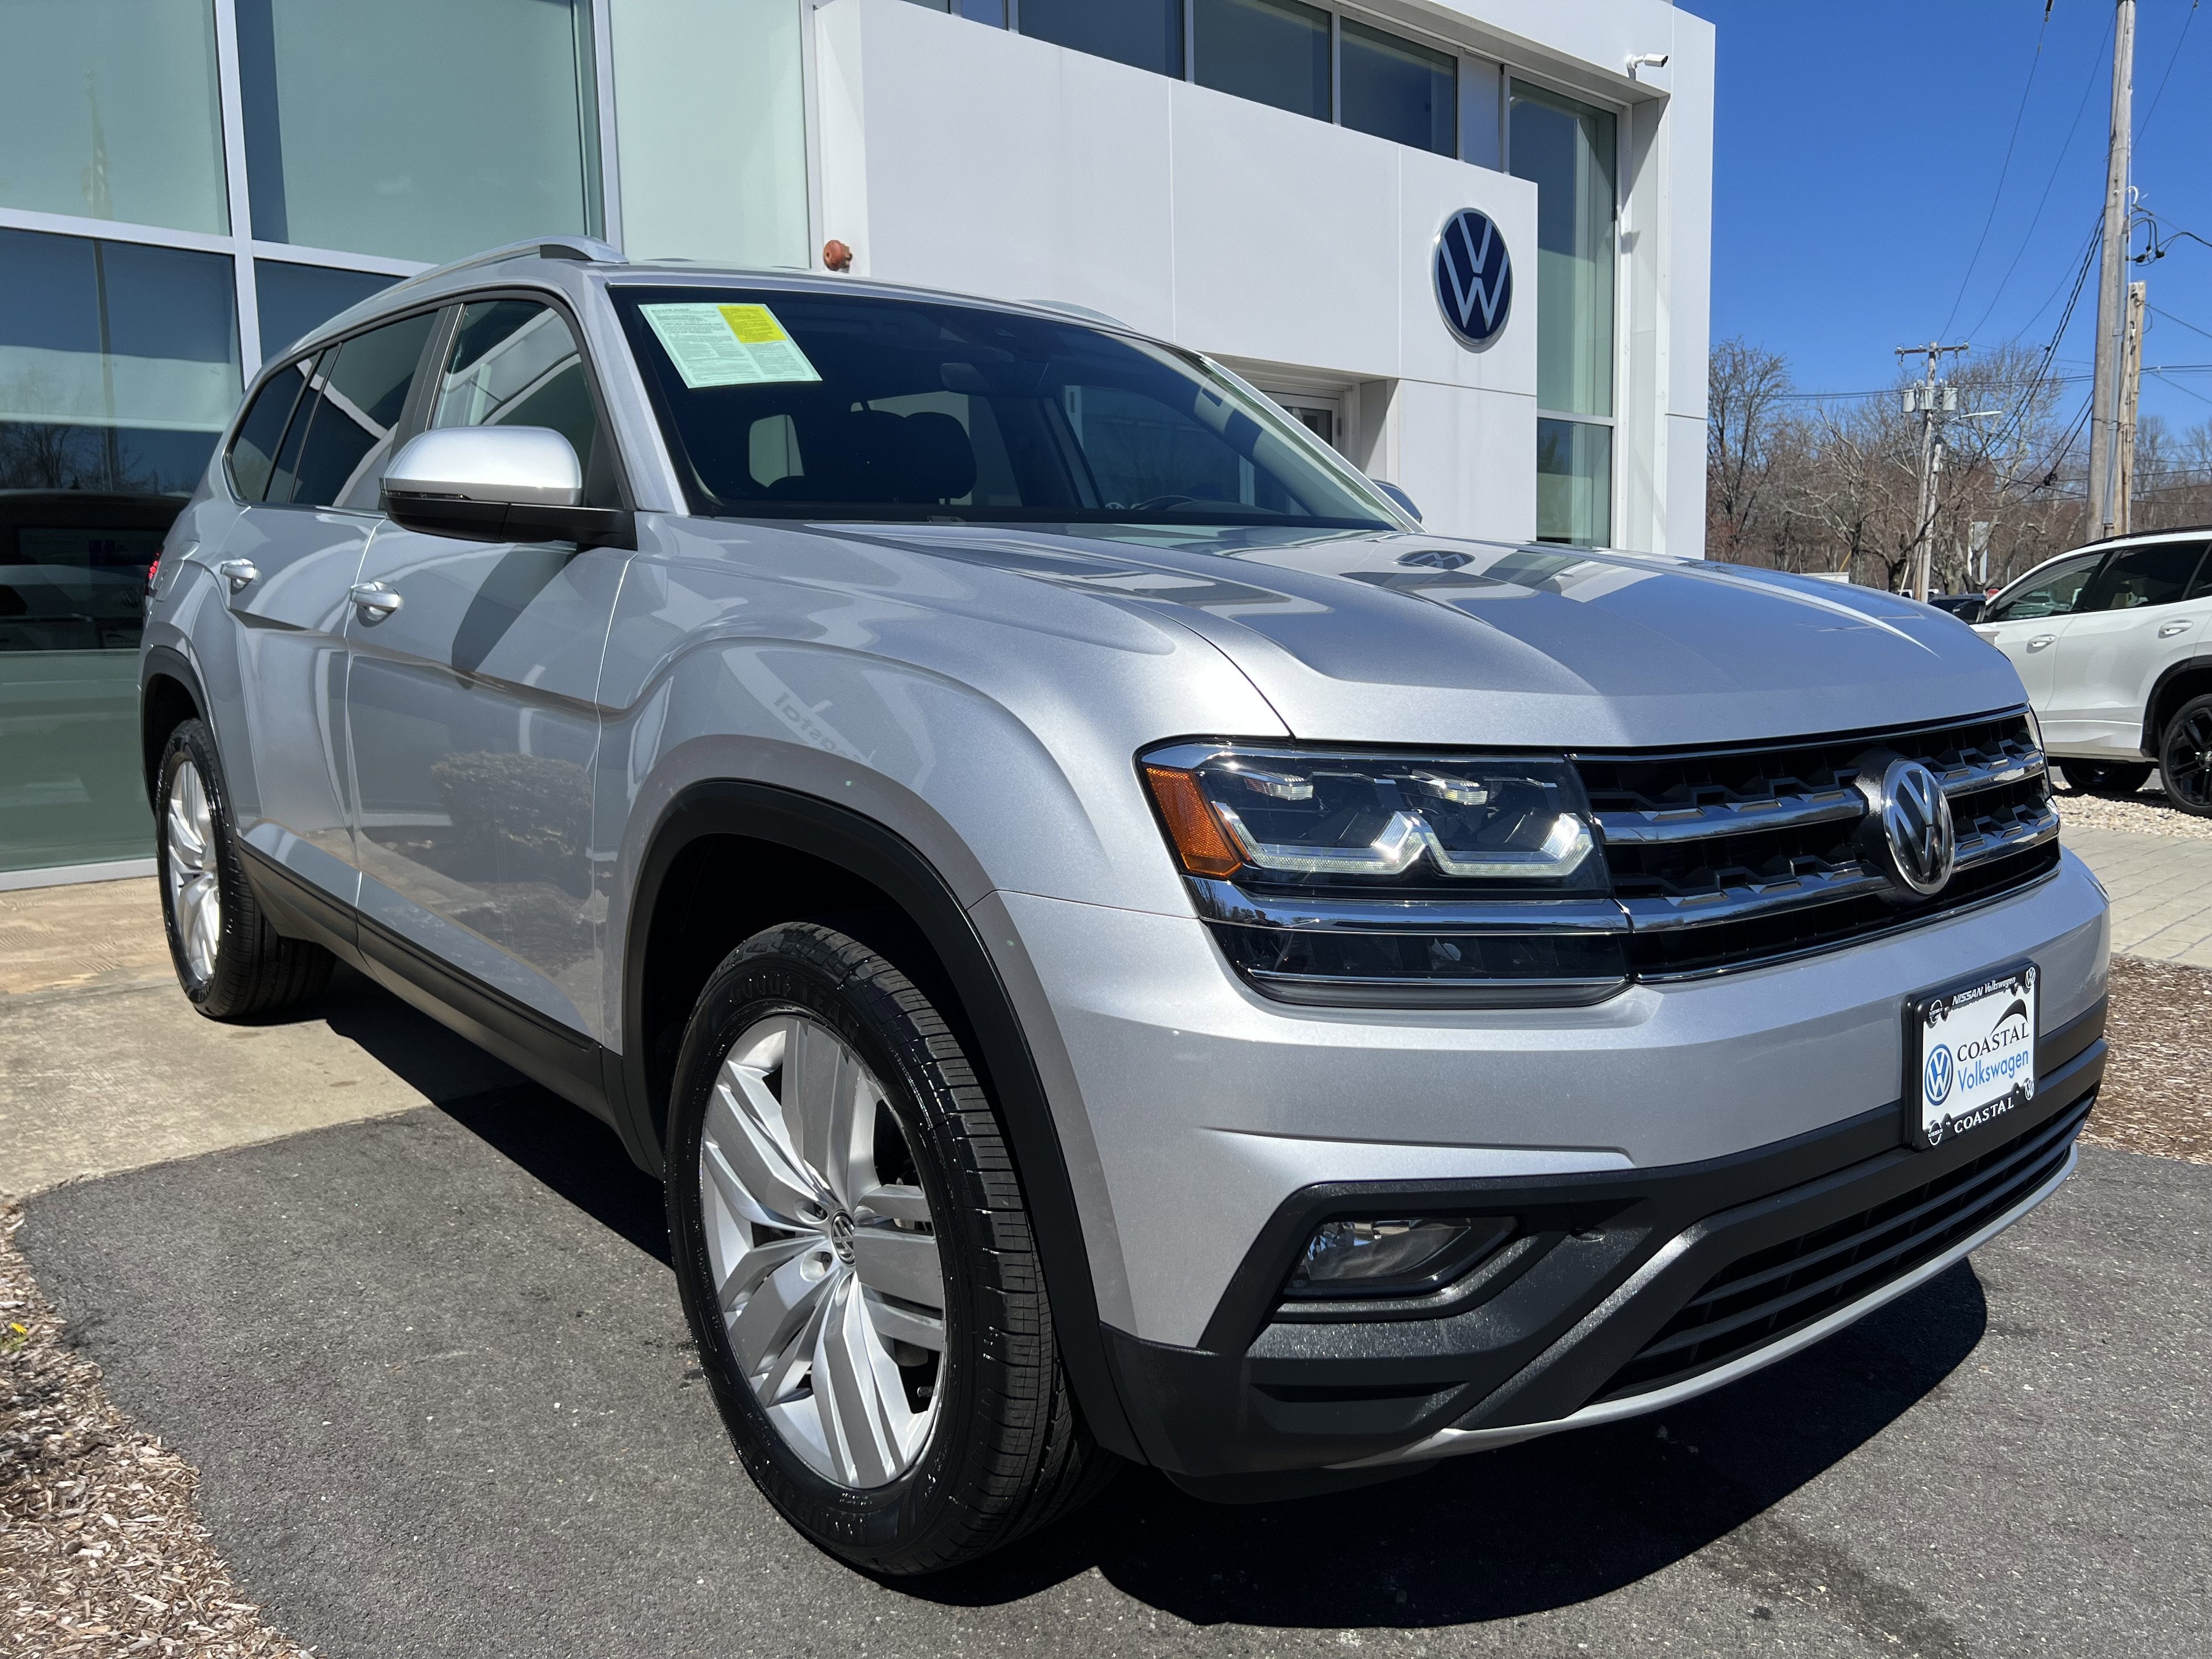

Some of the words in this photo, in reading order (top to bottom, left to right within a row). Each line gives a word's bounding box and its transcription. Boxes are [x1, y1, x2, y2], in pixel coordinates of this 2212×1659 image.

[1436, 210, 1512, 341] VW
[1891, 768, 1950, 886] VW
[1951, 986, 1984, 1006] NISSAN
[1984, 977, 2016, 994] Volkswagen
[1957, 1022, 2029, 1062] COASTAL
[1926, 1046, 1953, 1103] VW
[1957, 1050, 2029, 1093] Volkswagen
[1954, 1097, 2015, 1133] COASTAL
